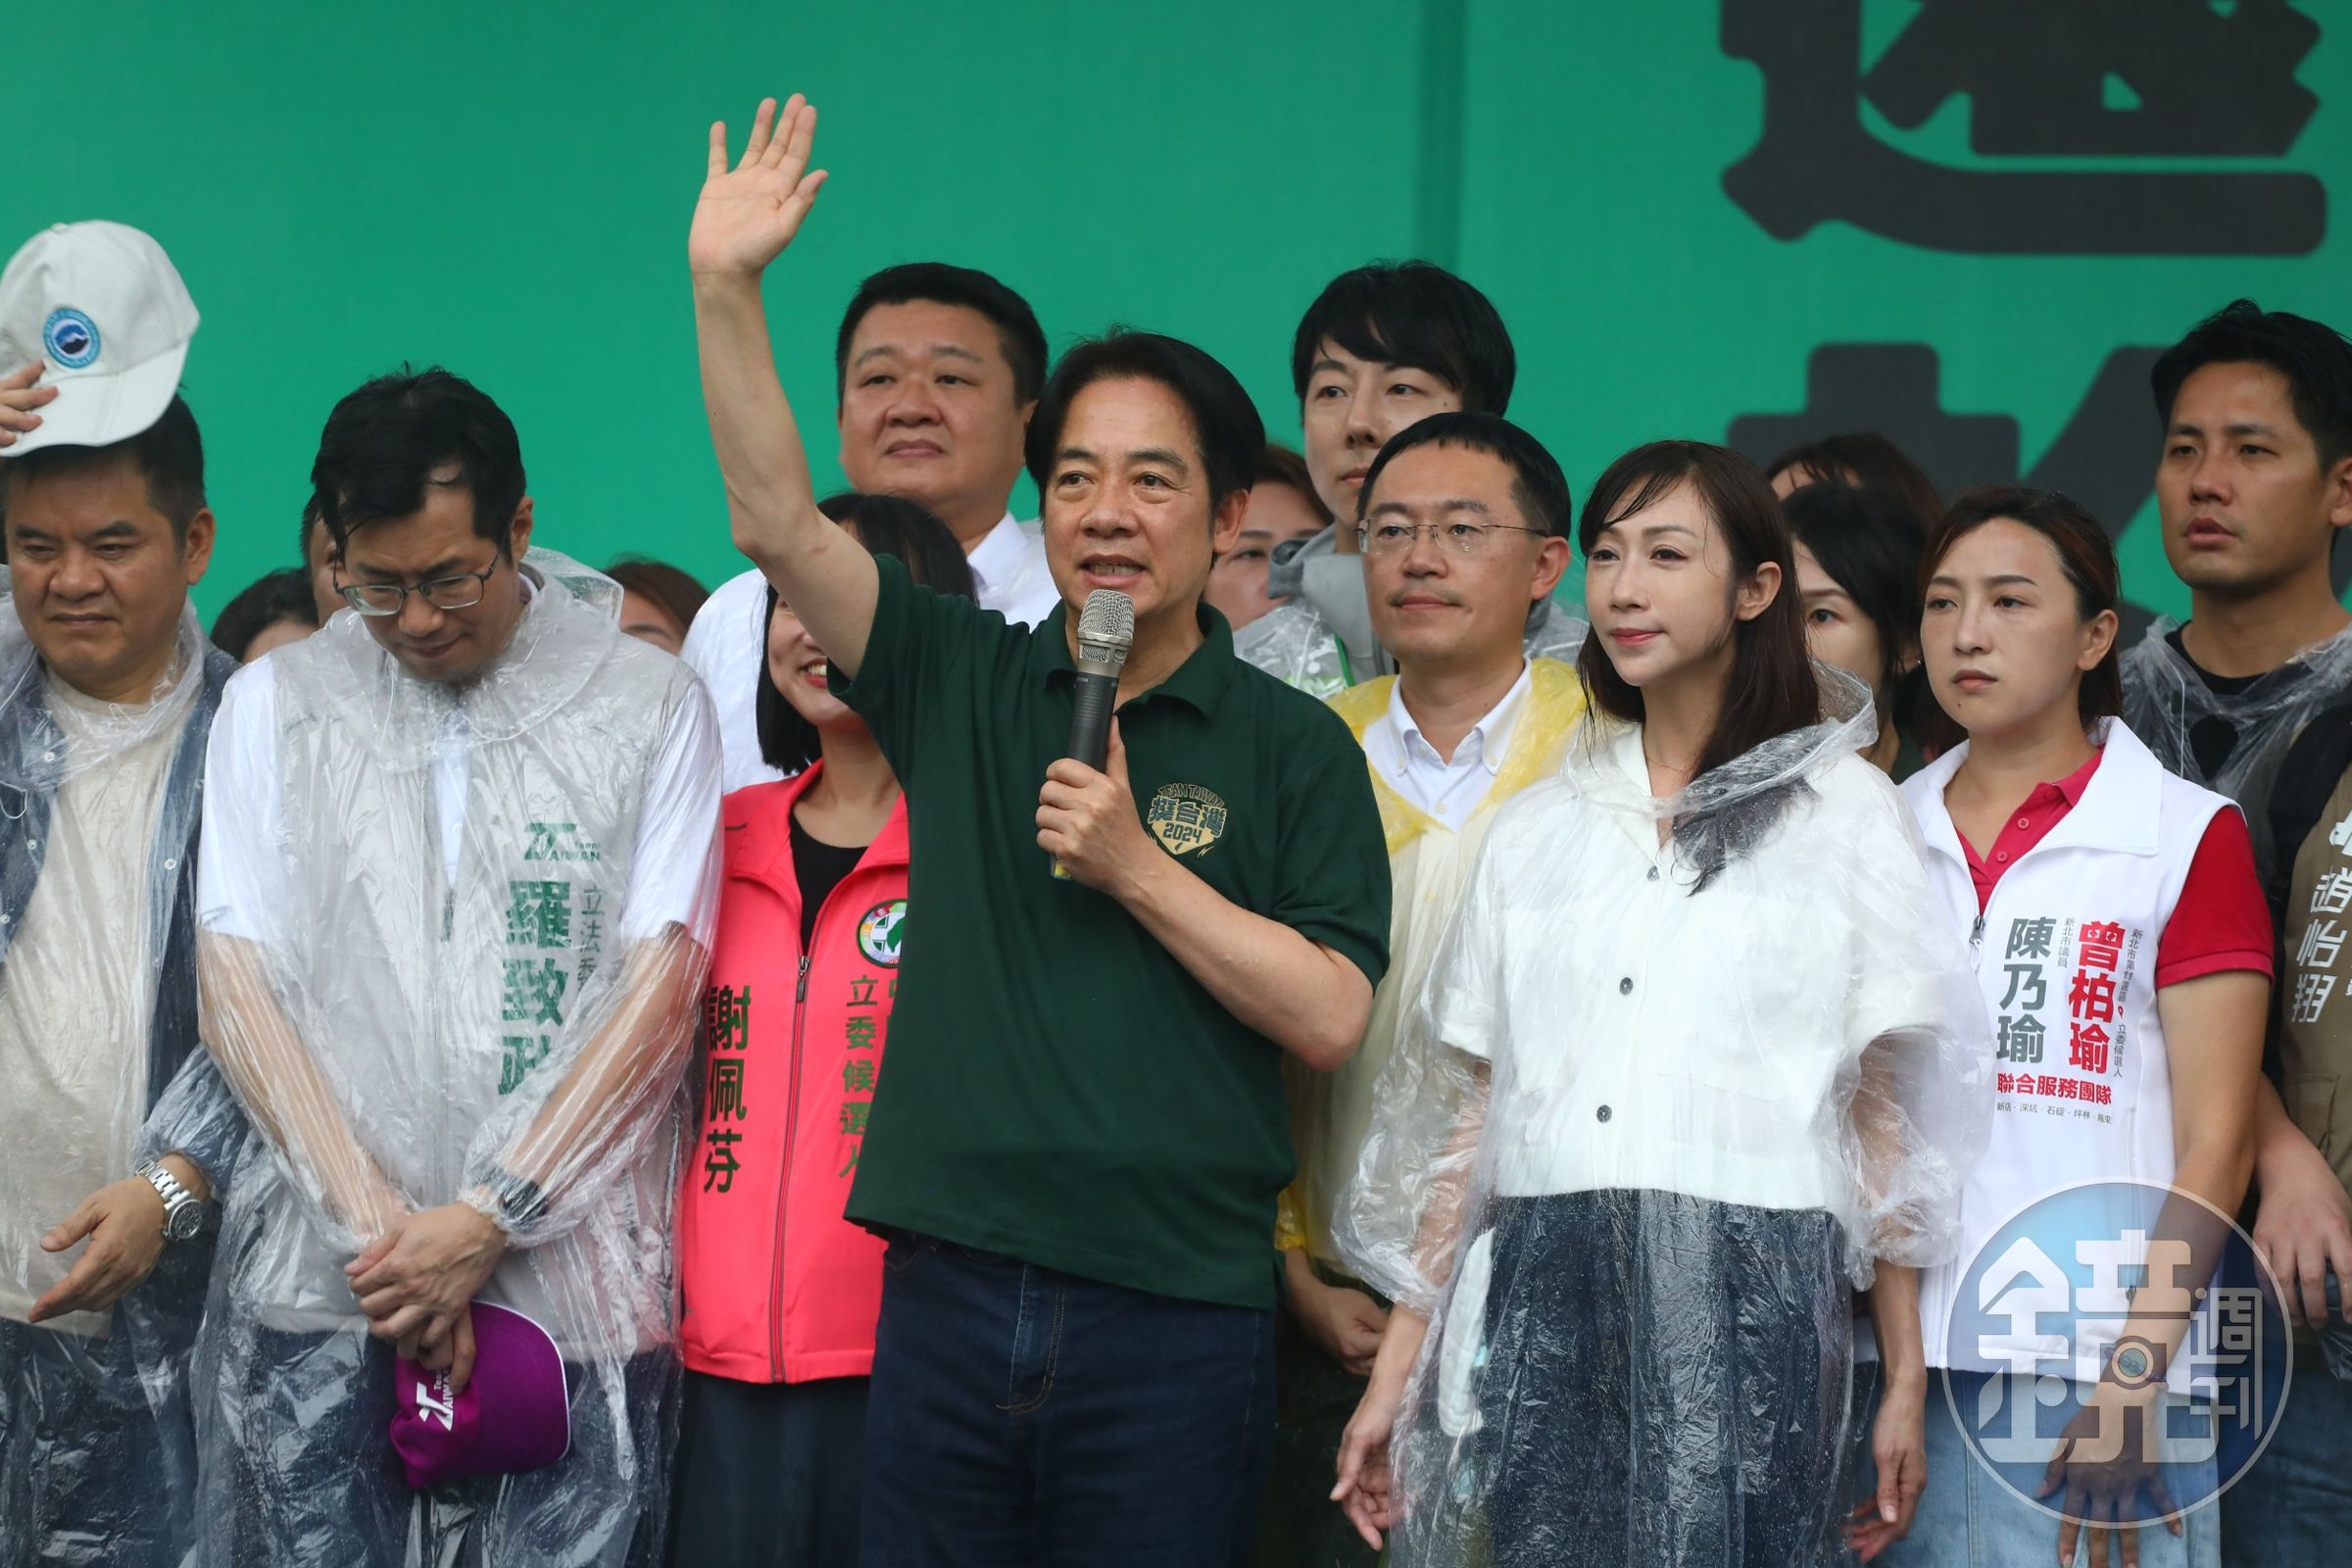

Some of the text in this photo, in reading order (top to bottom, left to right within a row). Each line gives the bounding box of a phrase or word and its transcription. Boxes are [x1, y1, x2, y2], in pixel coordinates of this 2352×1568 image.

[1162, 823, 1202, 844] 2024
[1996, 915, 2057, 1064] 陳乃瑜
[2057, 917, 2076, 968] 新北市議員
[2068, 920, 2126, 1075] 曾柏瑜
[704, 984, 752, 1194] 謝佩芬
[1997, 1073, 2112, 1105] 聯合服務團隊
